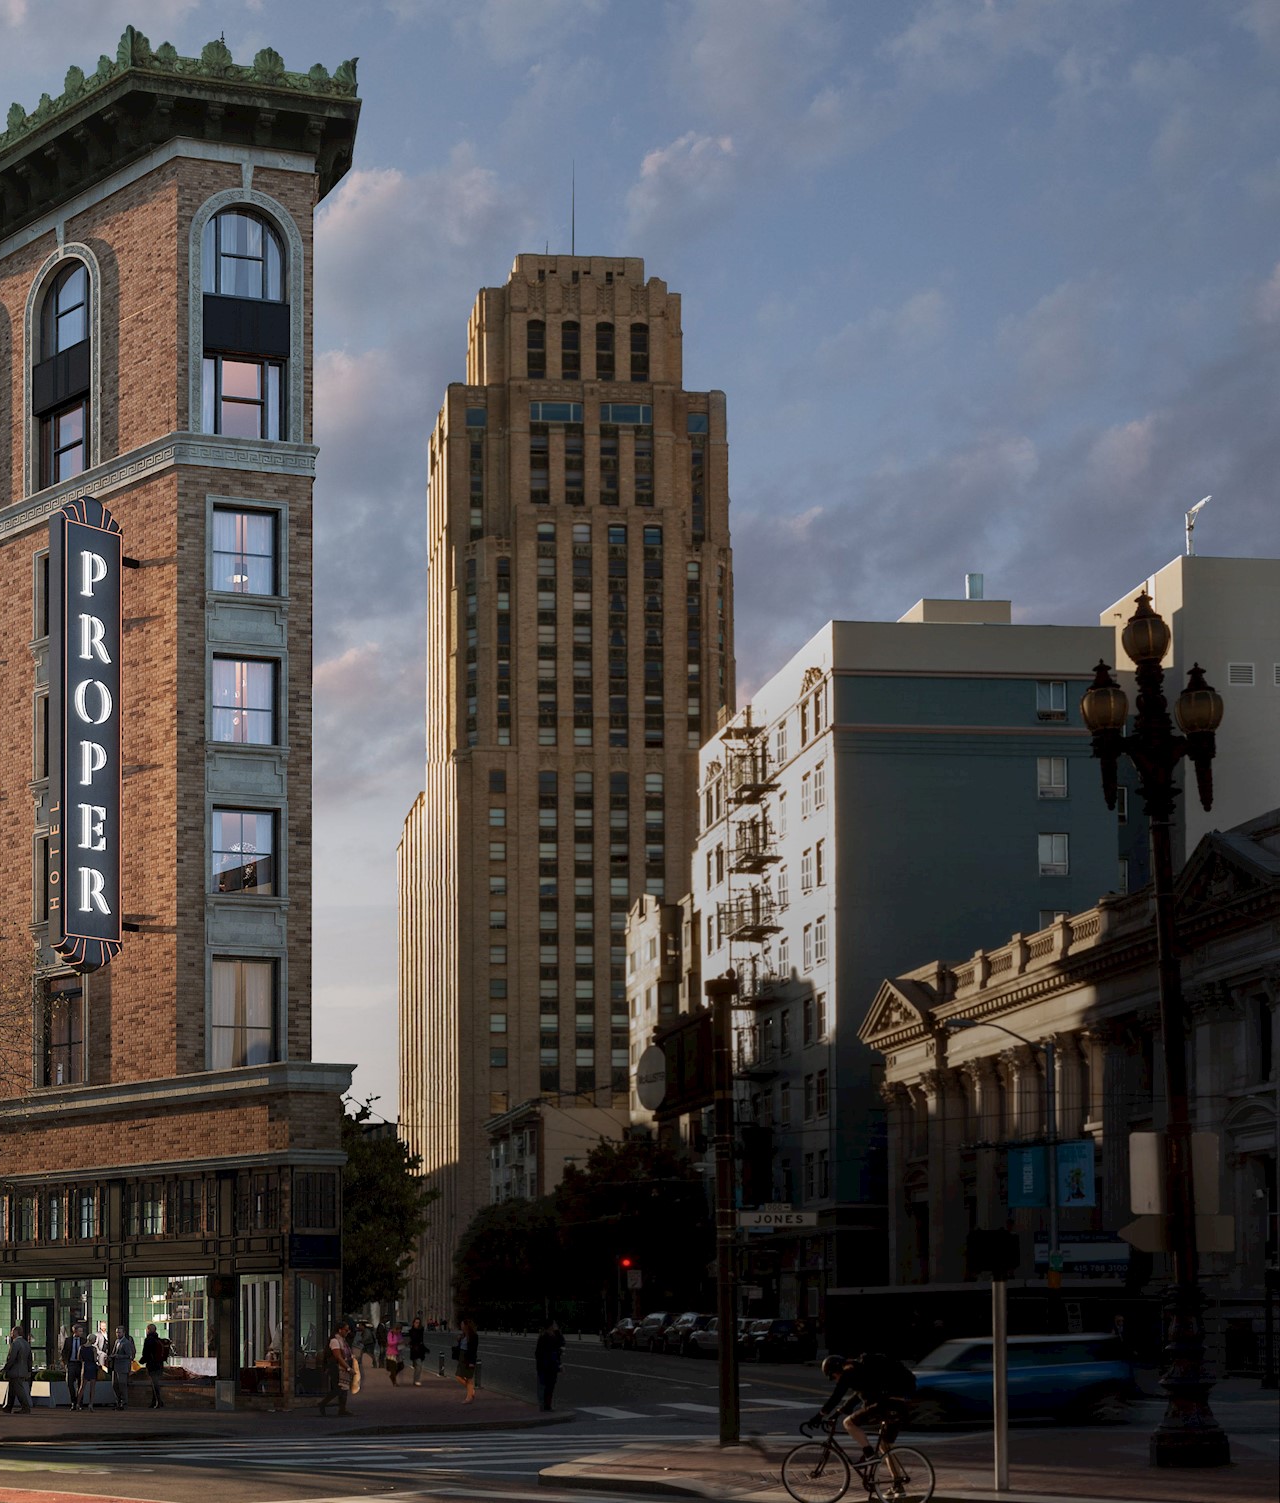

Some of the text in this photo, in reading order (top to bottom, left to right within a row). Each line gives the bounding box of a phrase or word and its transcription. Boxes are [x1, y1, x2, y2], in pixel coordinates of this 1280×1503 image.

[74, 550, 112, 915] PROPER
[49, 799, 59, 911] HOTEL
[754, 1215, 803, 1224] JONES
